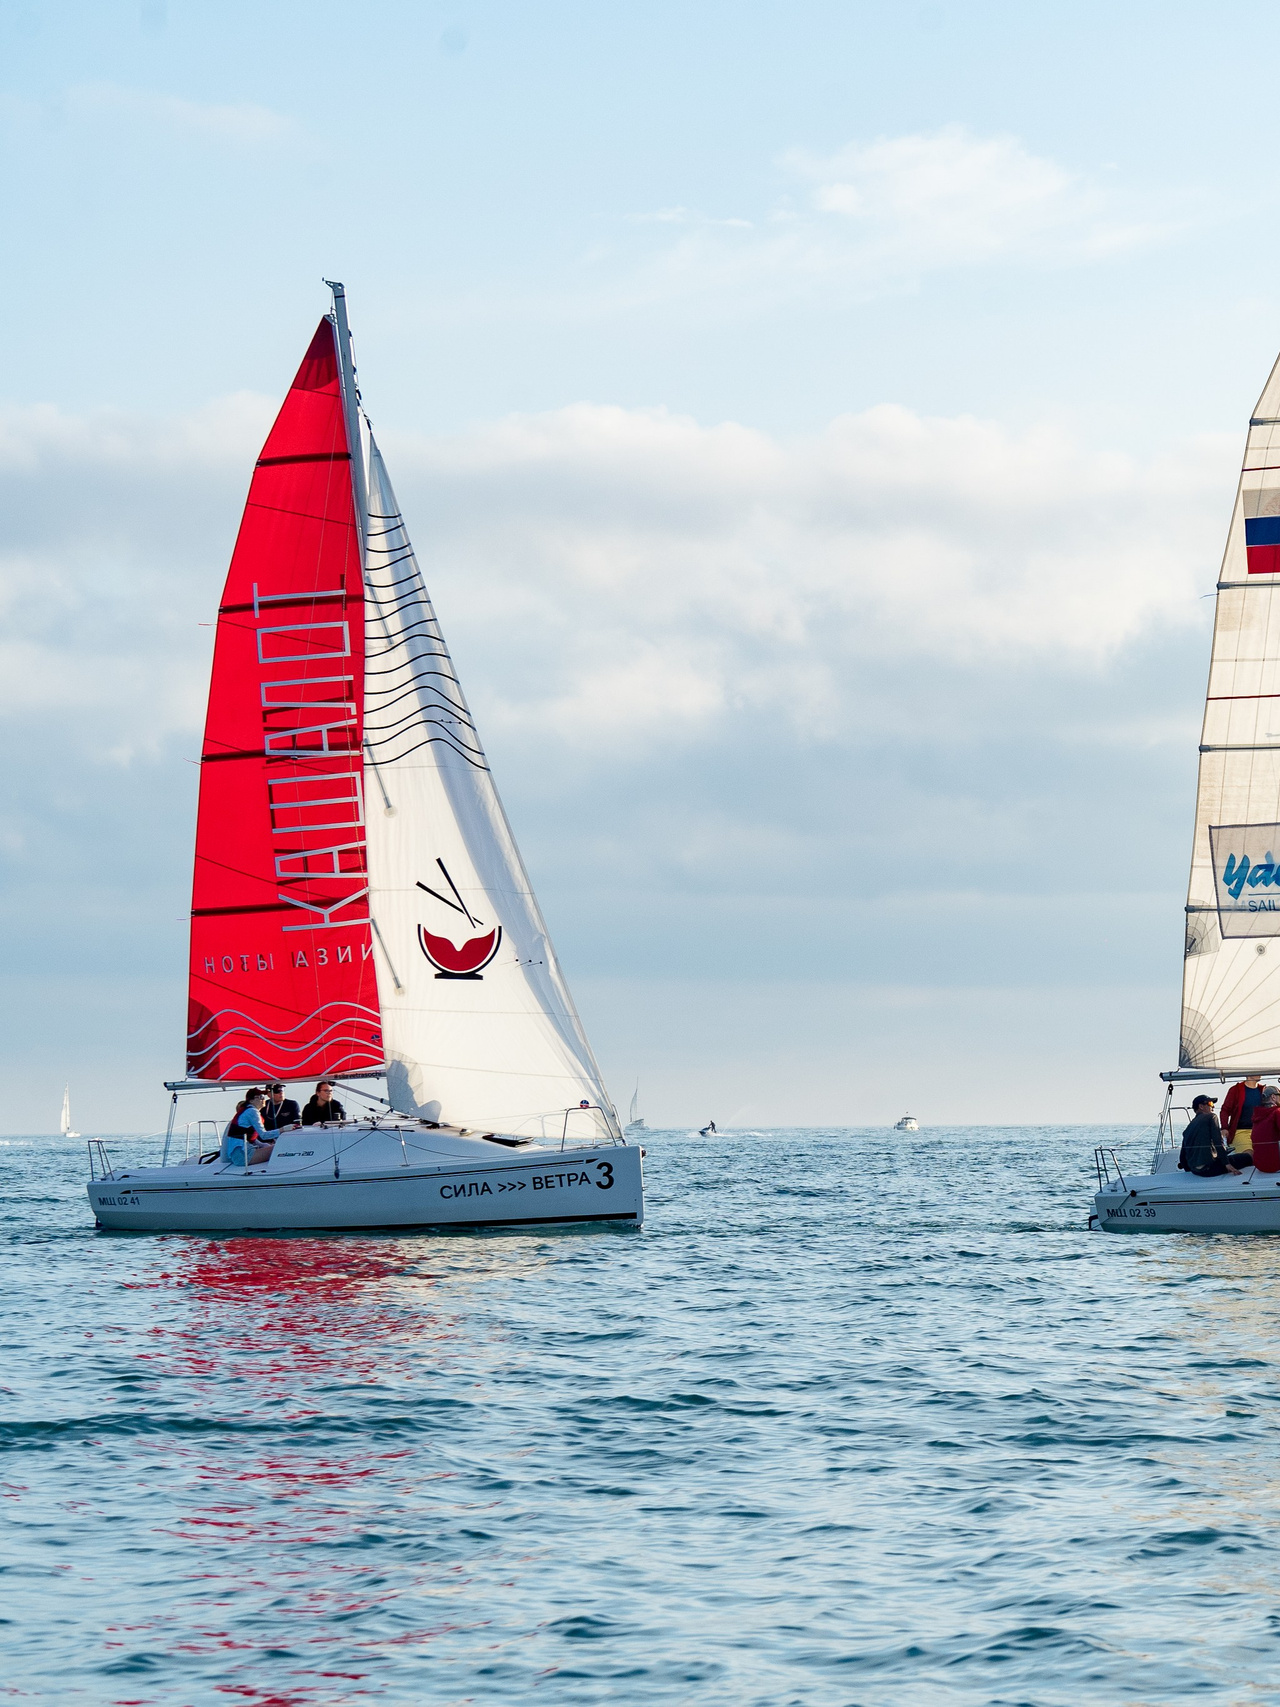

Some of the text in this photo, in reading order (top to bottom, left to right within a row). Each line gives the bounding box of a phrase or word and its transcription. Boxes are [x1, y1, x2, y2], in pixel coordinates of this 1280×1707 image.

[252, 582, 373, 932] КАШАЛОТ
[204, 942, 376, 974] НОТЫ АЗИИ
[439, 1161, 615, 1200] СИЛА ВЕТРА 3
[117, 1196, 128, 1206] 02
[130, 1196, 140, 1206] 41
[1129, 1208, 1142, 1218] 02
[1144, 1208, 1156, 1218] 39
